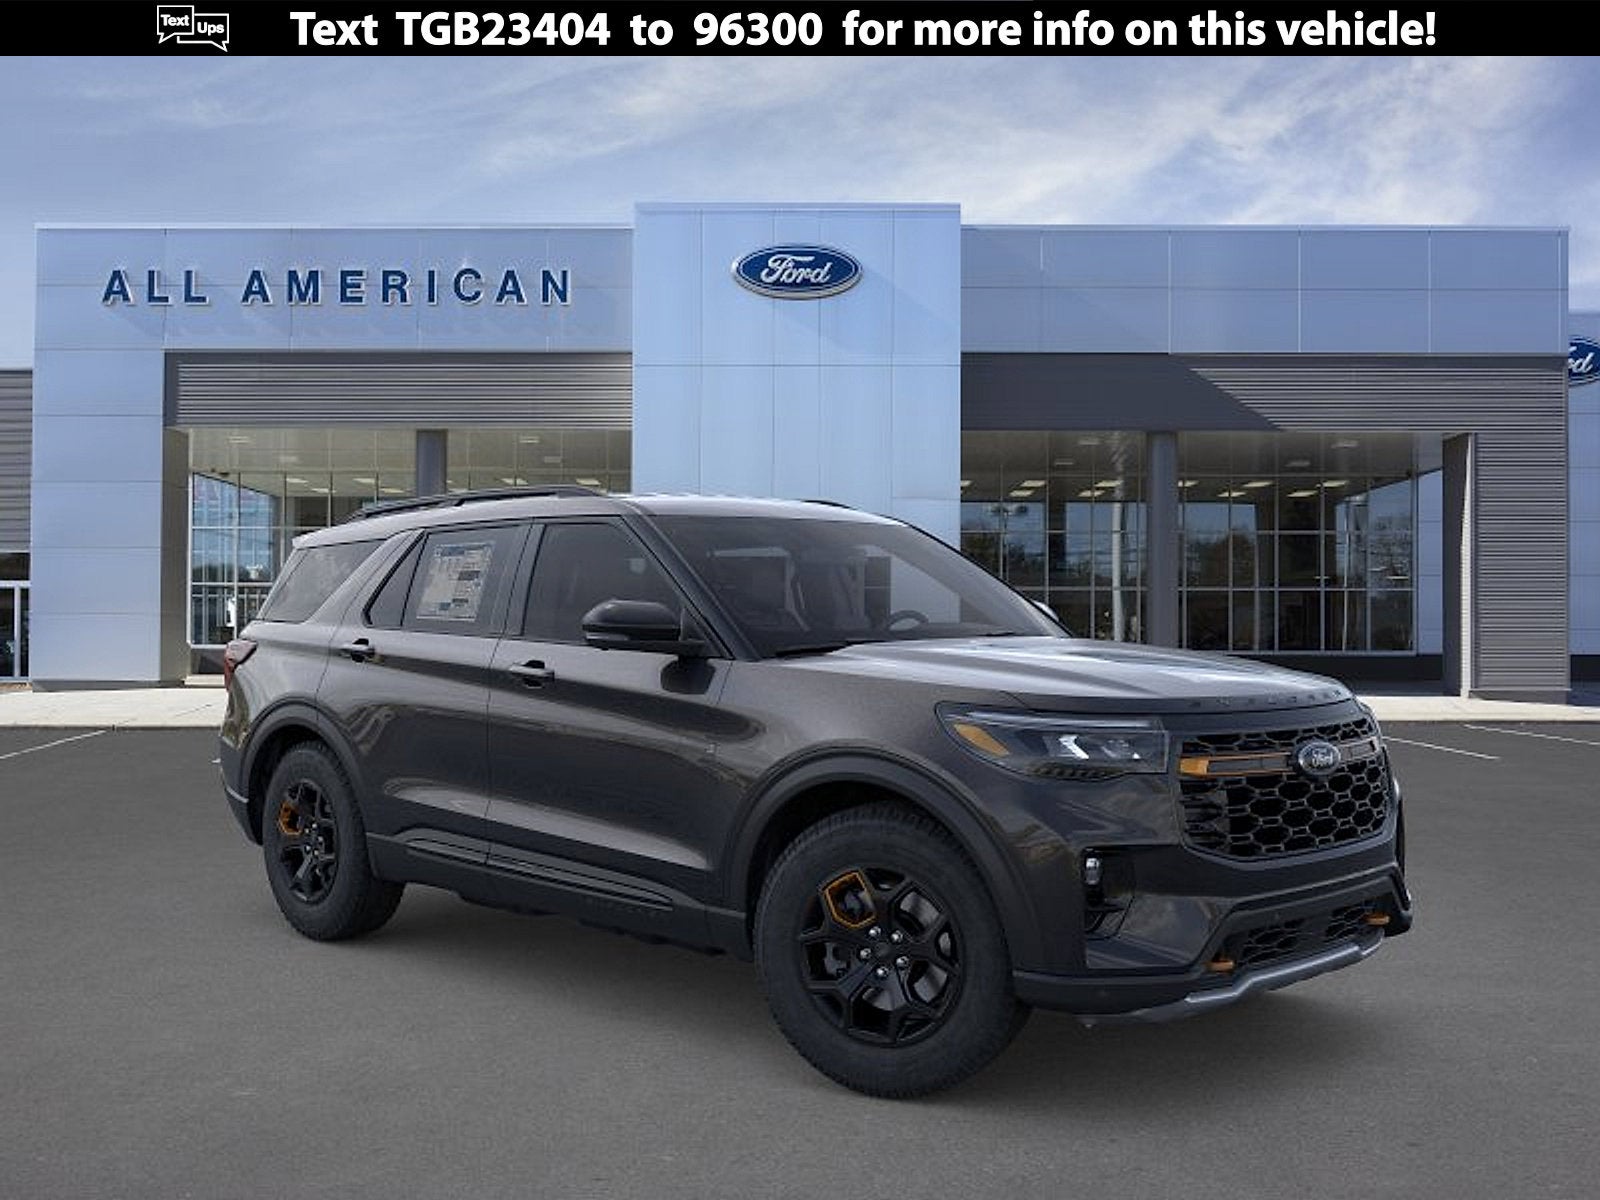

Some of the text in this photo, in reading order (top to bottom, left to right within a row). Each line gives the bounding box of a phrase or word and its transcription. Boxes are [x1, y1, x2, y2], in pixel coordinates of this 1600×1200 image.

[102, 266, 572, 305] ALL AMERICAN
[761, 254, 833, 283] Ford
